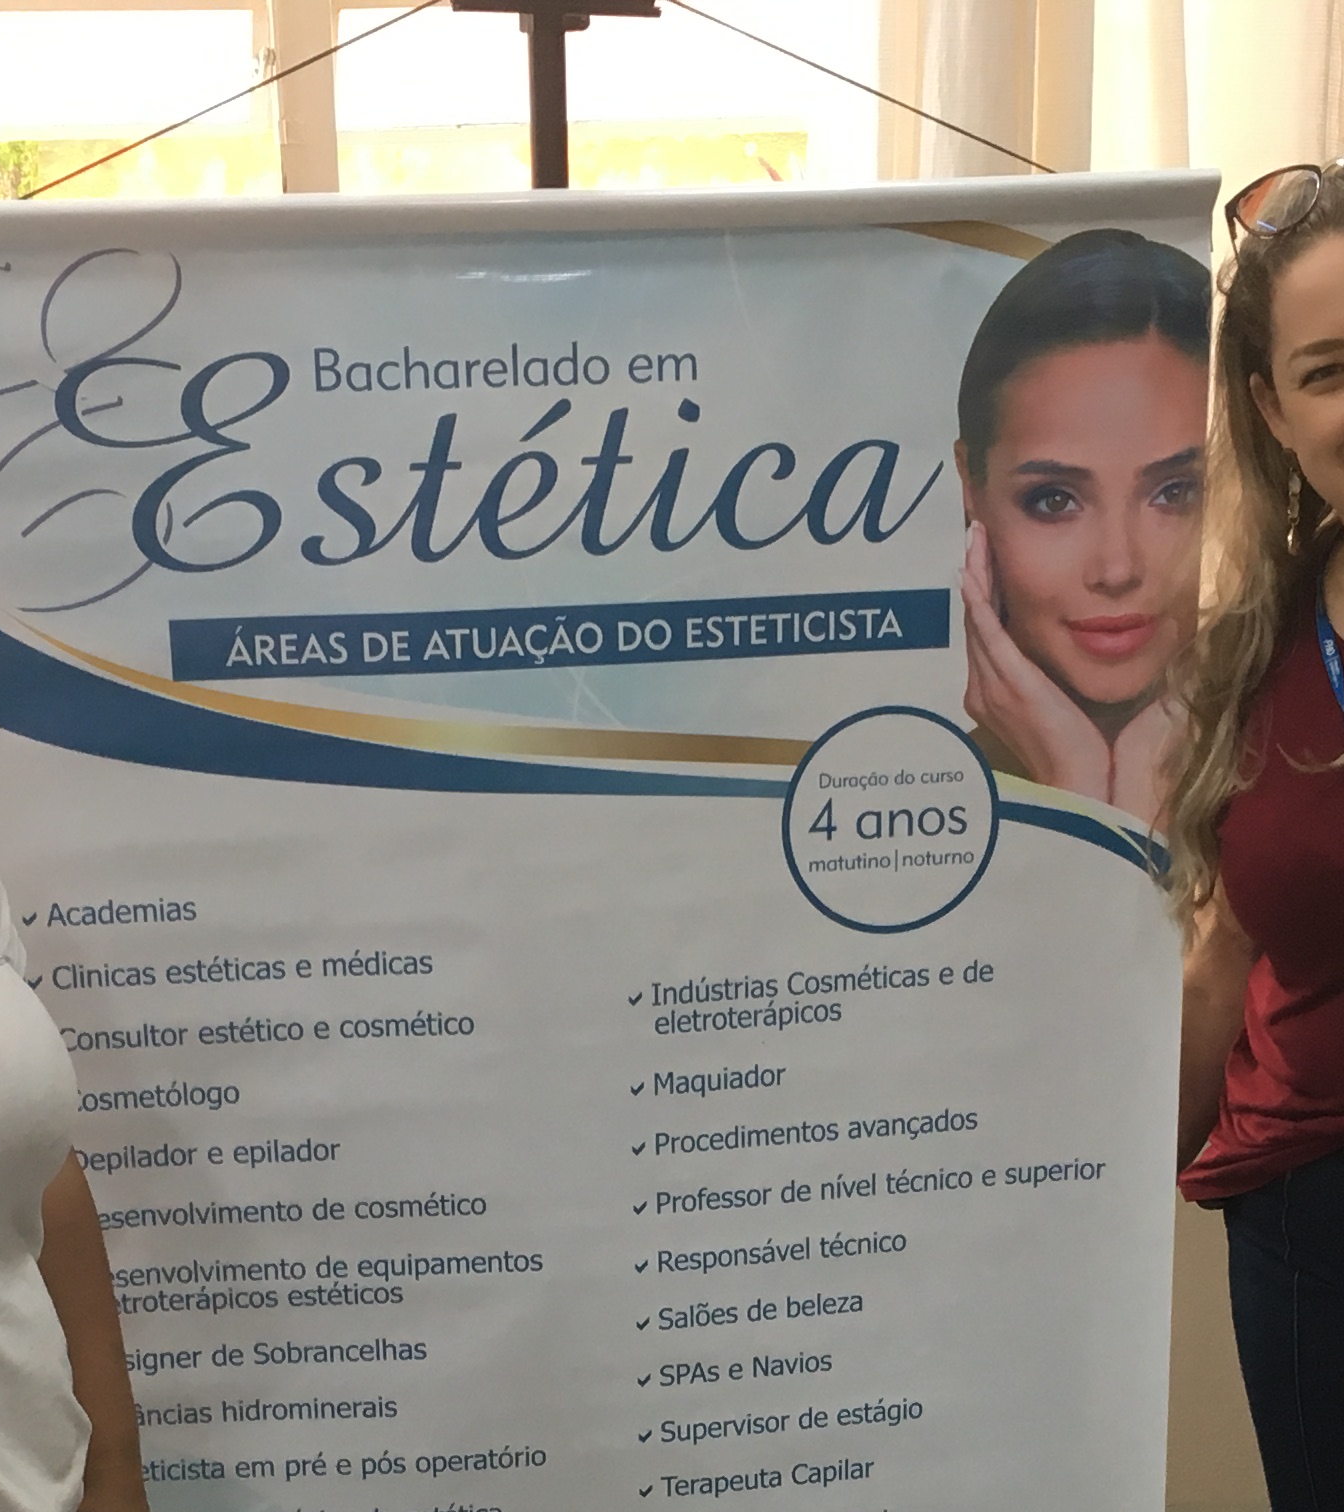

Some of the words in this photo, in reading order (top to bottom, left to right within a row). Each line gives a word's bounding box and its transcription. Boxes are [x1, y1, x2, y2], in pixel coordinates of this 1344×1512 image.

[313, 341, 611, 393] Bacharelado
[627, 351, 699, 385] em
[55, 350, 945, 574] Estética
[225, 625, 349, 667] ÁREAS
[362, 630, 412, 663] DE
[423, 616, 604, 665] ATUAÇÃO
[617, 618, 672, 652] DO
[685, 608, 904, 650] ESTETICISTA
[818, 772, 889, 791] Duração
[894, 768, 916, 786] do
[920, 770, 965, 784] curso
[808, 797, 838, 842] 4
[855, 805, 969, 840] anos
[46, 897, 198, 928] Academias
[52, 963, 157, 990] Clinicas
[165, 954, 287, 986] estéticas
[295, 958, 313, 979] e
[322, 948, 434, 978] médicas
[651, 976, 779, 1006] Indústrias
[786, 964, 930, 997] Cosméticas
[938, 967, 954, 986] e
[963, 960, 995, 984] de
[60, 1023, 189, 1051] Consultor
[198, 1016, 305, 1045] estético
[313, 1019, 330, 1040] e
[339, 1010, 475, 1039] cosmético
[654, 1000, 843, 1035] eletroterápicos
[77, 1081, 240, 1112] osmetólogo
[653, 1063, 787, 1098] Maquiador
[654, 1119, 839, 1156] Procedimentos
[847, 1108, 978, 1141] avançados
[207, 1145, 223, 1165] e
[232, 1138, 341, 1169] epilador
[655, 1182, 772, 1215] Professor
[780, 1179, 812, 1203] de
[820, 1173, 877, 1201] nível
[885, 1166, 973, 1194] técnico
[981, 1168, 997, 1187] e
[1004, 1157, 1106, 1190] superior
[98, 1200, 303, 1231] esenvolvimento
[312, 1197, 345, 1221] de
[354, 1191, 487, 1220] cosmético
[112, 1258, 307, 1289] senvolvimento
[315, 1255, 349, 1280] de
[357, 1250, 544, 1284] equipamentos
[657, 1236, 811, 1274] Responsável
[819, 1230, 908, 1258] técnico
[116, 1286, 279, 1316] troterápicos
[287, 1281, 404, 1307] estéticos
[657, 1302, 739, 1331] Salões
[746, 1298, 778, 1322] de
[785, 1292, 864, 1319] beleza
[126, 1348, 203, 1376] signer
[211, 1343, 245, 1368] de
[253, 1337, 428, 1366] Sobrancelhas
[658, 1360, 720, 1388] SPAs
[728, 1361, 744, 1381] e
[751, 1351, 833, 1379] Navios
[135, 1403, 213, 1427] âncias
[221, 1397, 398, 1423] hidrominerais
[659, 1411, 791, 1446] Supervisor
[797, 1406, 829, 1430] de
[836, 1397, 924, 1428] estágio
[142, 1458, 226, 1482] eticista
[234, 1460, 275, 1479] em
[285, 1450, 327, 1482] pré
[335, 1458, 352, 1478] e
[360, 1449, 407, 1480] pós
[415, 1444, 548, 1478] operatório
[661, 1467, 783, 1499] Terapeuta
[790, 1457, 875, 1488] Capilar
